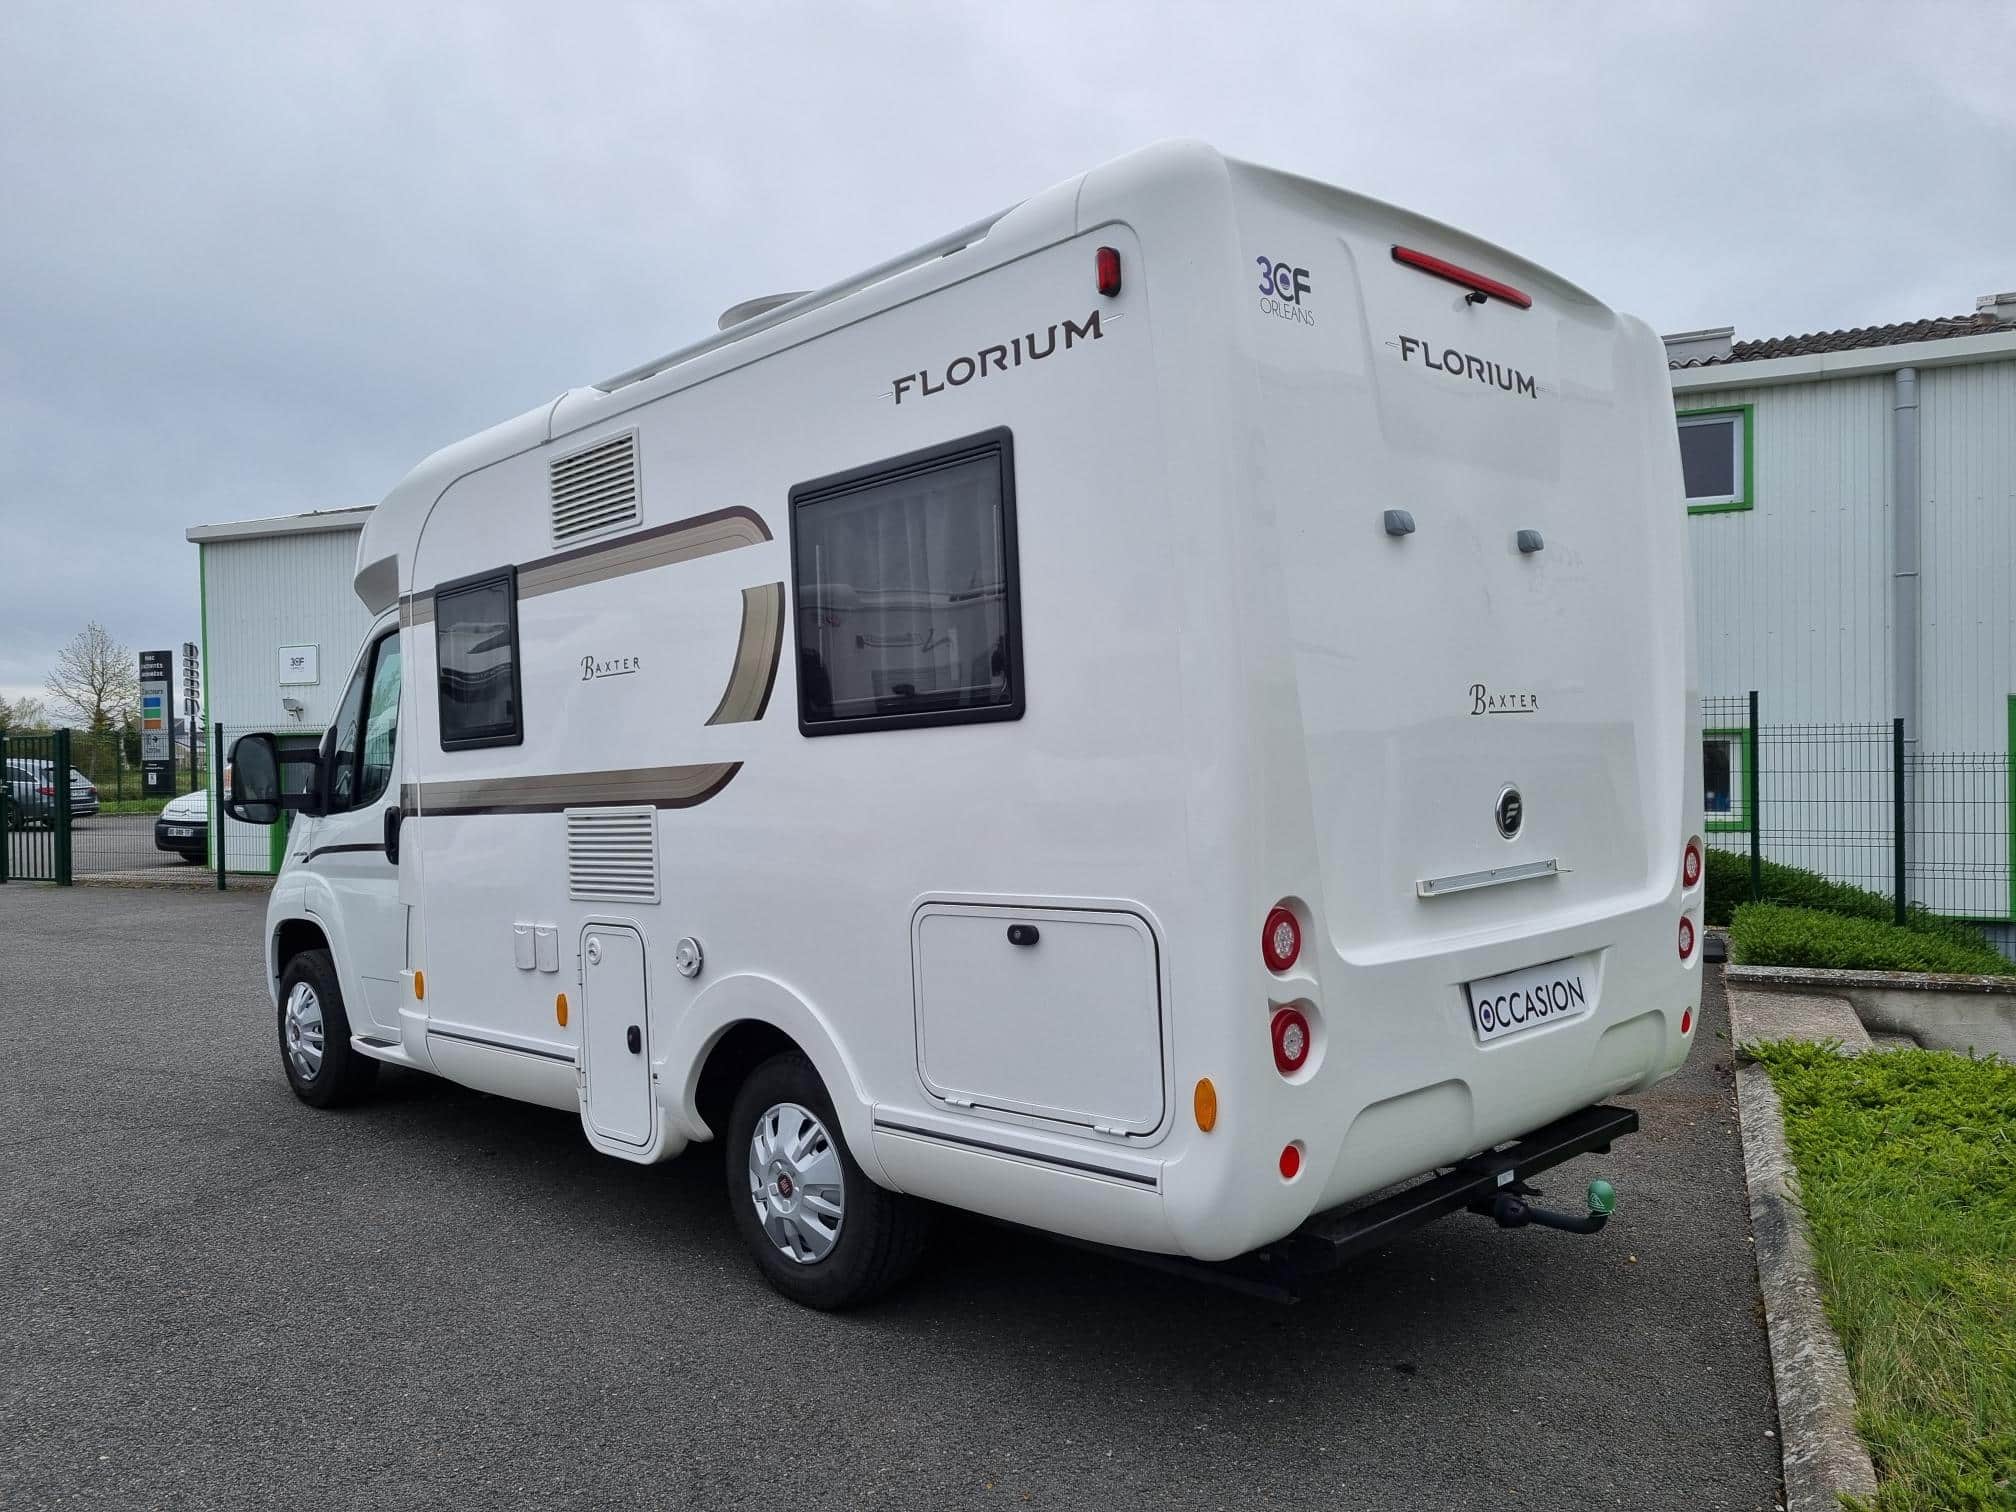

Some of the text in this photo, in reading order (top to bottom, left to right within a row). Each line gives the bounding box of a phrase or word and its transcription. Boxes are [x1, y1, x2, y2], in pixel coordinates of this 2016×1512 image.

[1256, 256, 1311, 305] 3CF
[1260, 298, 1315, 327] ORLEANS
[893, 309, 1103, 404] FLORIUM
[1399, 336, 1537, 399] FLORIUM
[1479, 976, 1585, 1032] OCCASION
